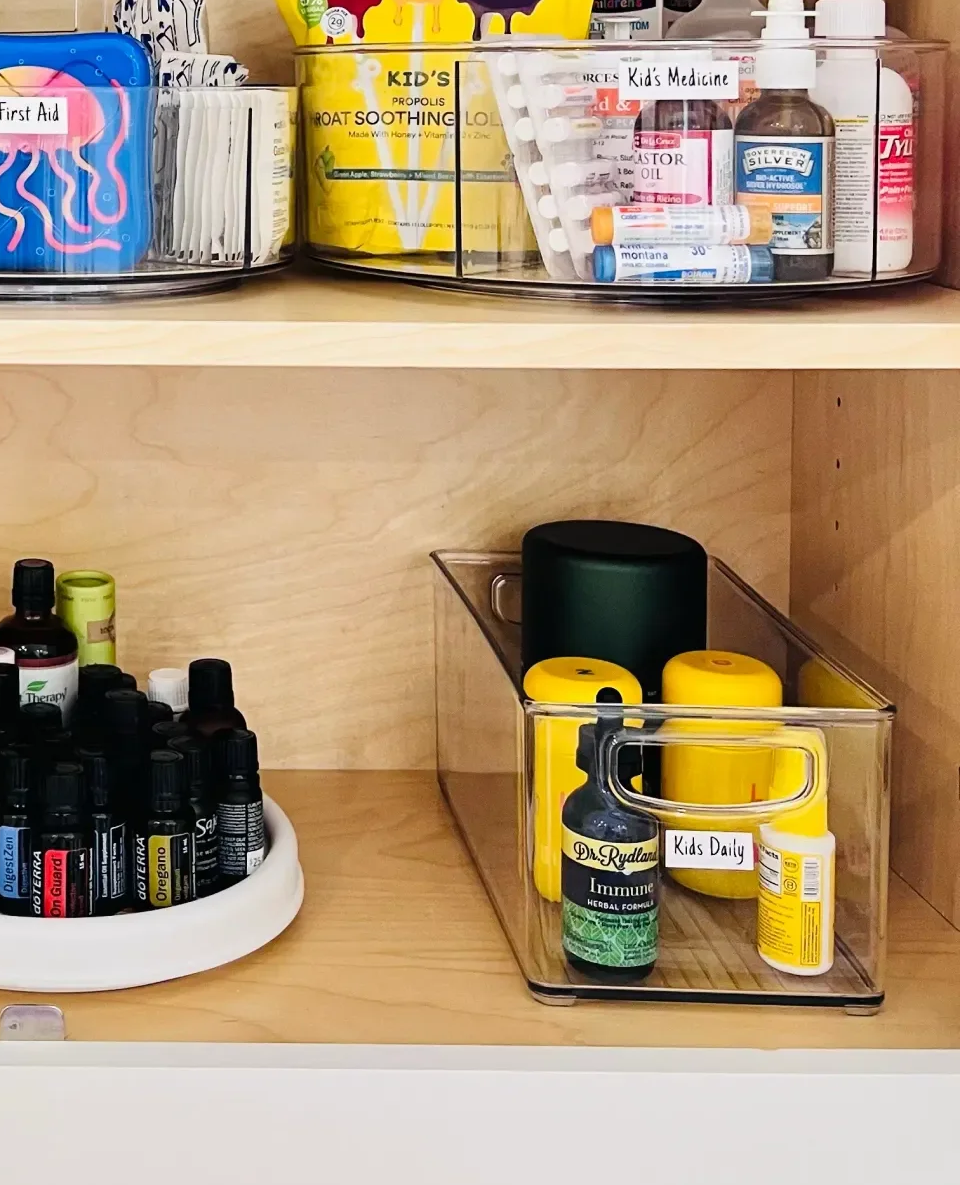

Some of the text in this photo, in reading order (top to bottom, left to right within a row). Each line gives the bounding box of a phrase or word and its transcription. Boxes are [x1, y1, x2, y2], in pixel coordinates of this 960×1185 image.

[331, 17, 343, 27] 2g
[387, 70, 451, 88] KID'S
[628, 67, 729, 88] Kid's Medicine
[392, 97, 445, 107] PROPOLIS
[37, 101, 60, 123] Aid
[311, 111, 504, 127] ROAT SOOTHING LOL
[348, 131, 370, 139] Made
[391, 131, 416, 140] Honey
[747, 148, 807, 159] SOVEREIGN
[748, 157, 806, 168] SILVER
[641, 168, 663, 180] OIL
[756, 174, 795, 183] BIO-ACTIVE
[656, 194, 682, 203] Ricino
[621, 251, 669, 260] montana
[25, 688, 67, 703] Therapy
[674, 835, 746, 865] Kids Daily
[3, 836, 16, 893] DigestZen
[156, 846, 169, 902] Oregano
[50, 856, 63, 917] On Guard
[590, 877, 655, 898] Immune
[587, 898, 655, 911] HERBAL FORMULA
